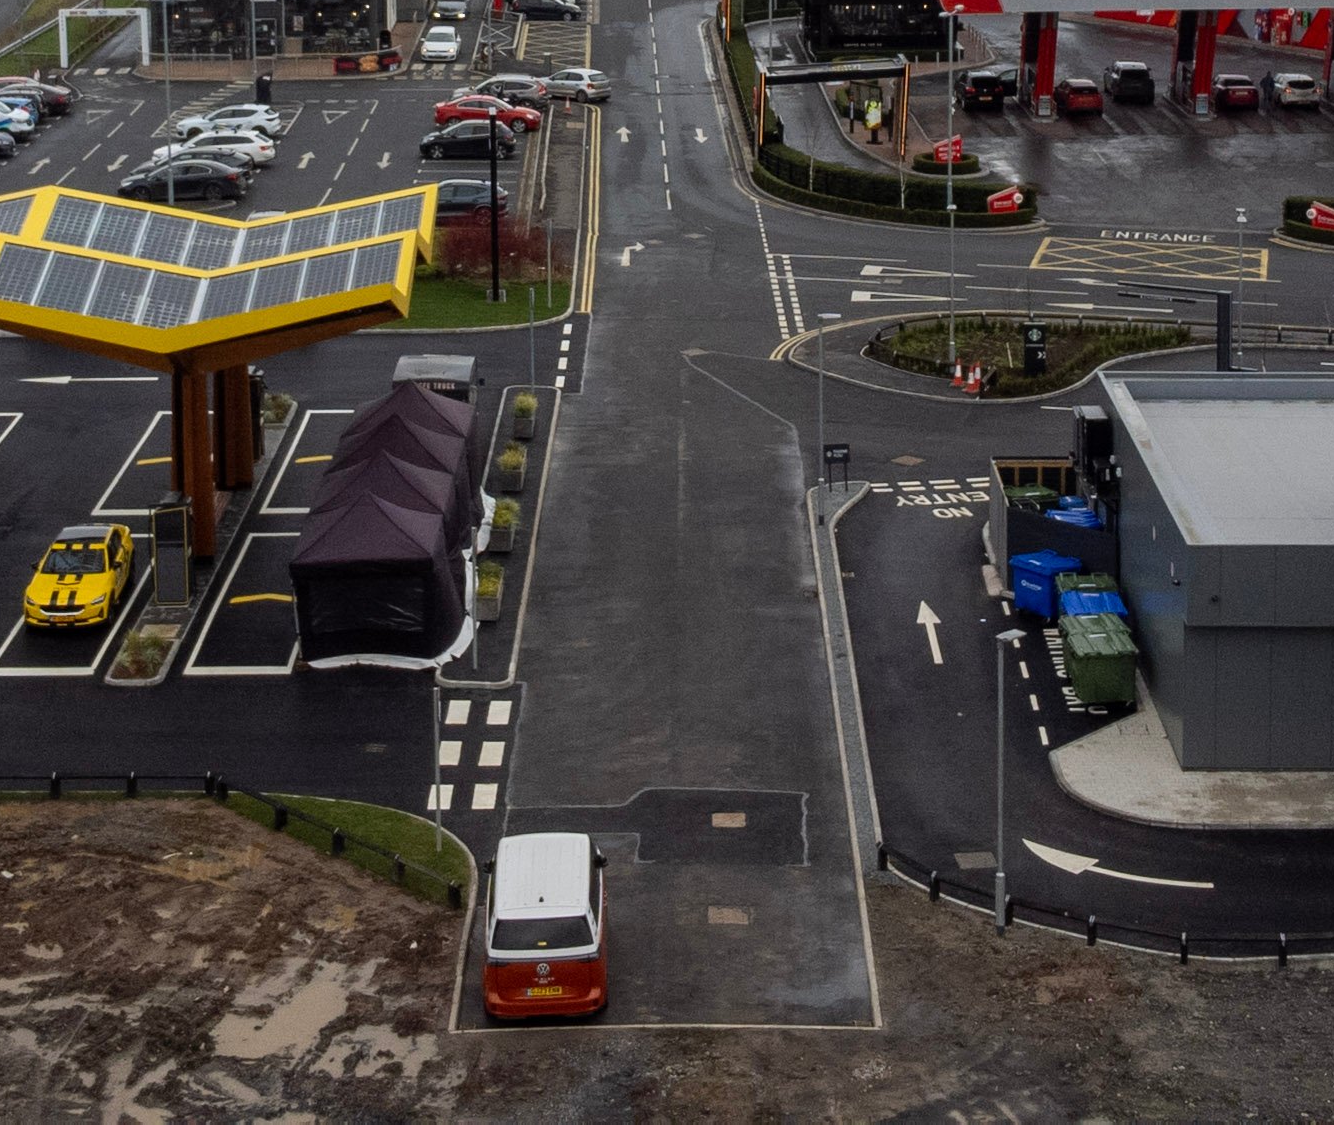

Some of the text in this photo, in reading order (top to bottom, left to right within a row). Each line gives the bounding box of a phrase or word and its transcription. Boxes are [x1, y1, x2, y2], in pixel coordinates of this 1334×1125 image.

[1100, 229, 1217, 243] ENTRANCE
[896, 491, 990, 507] ENTRY
[932, 507, 974, 518] NO
